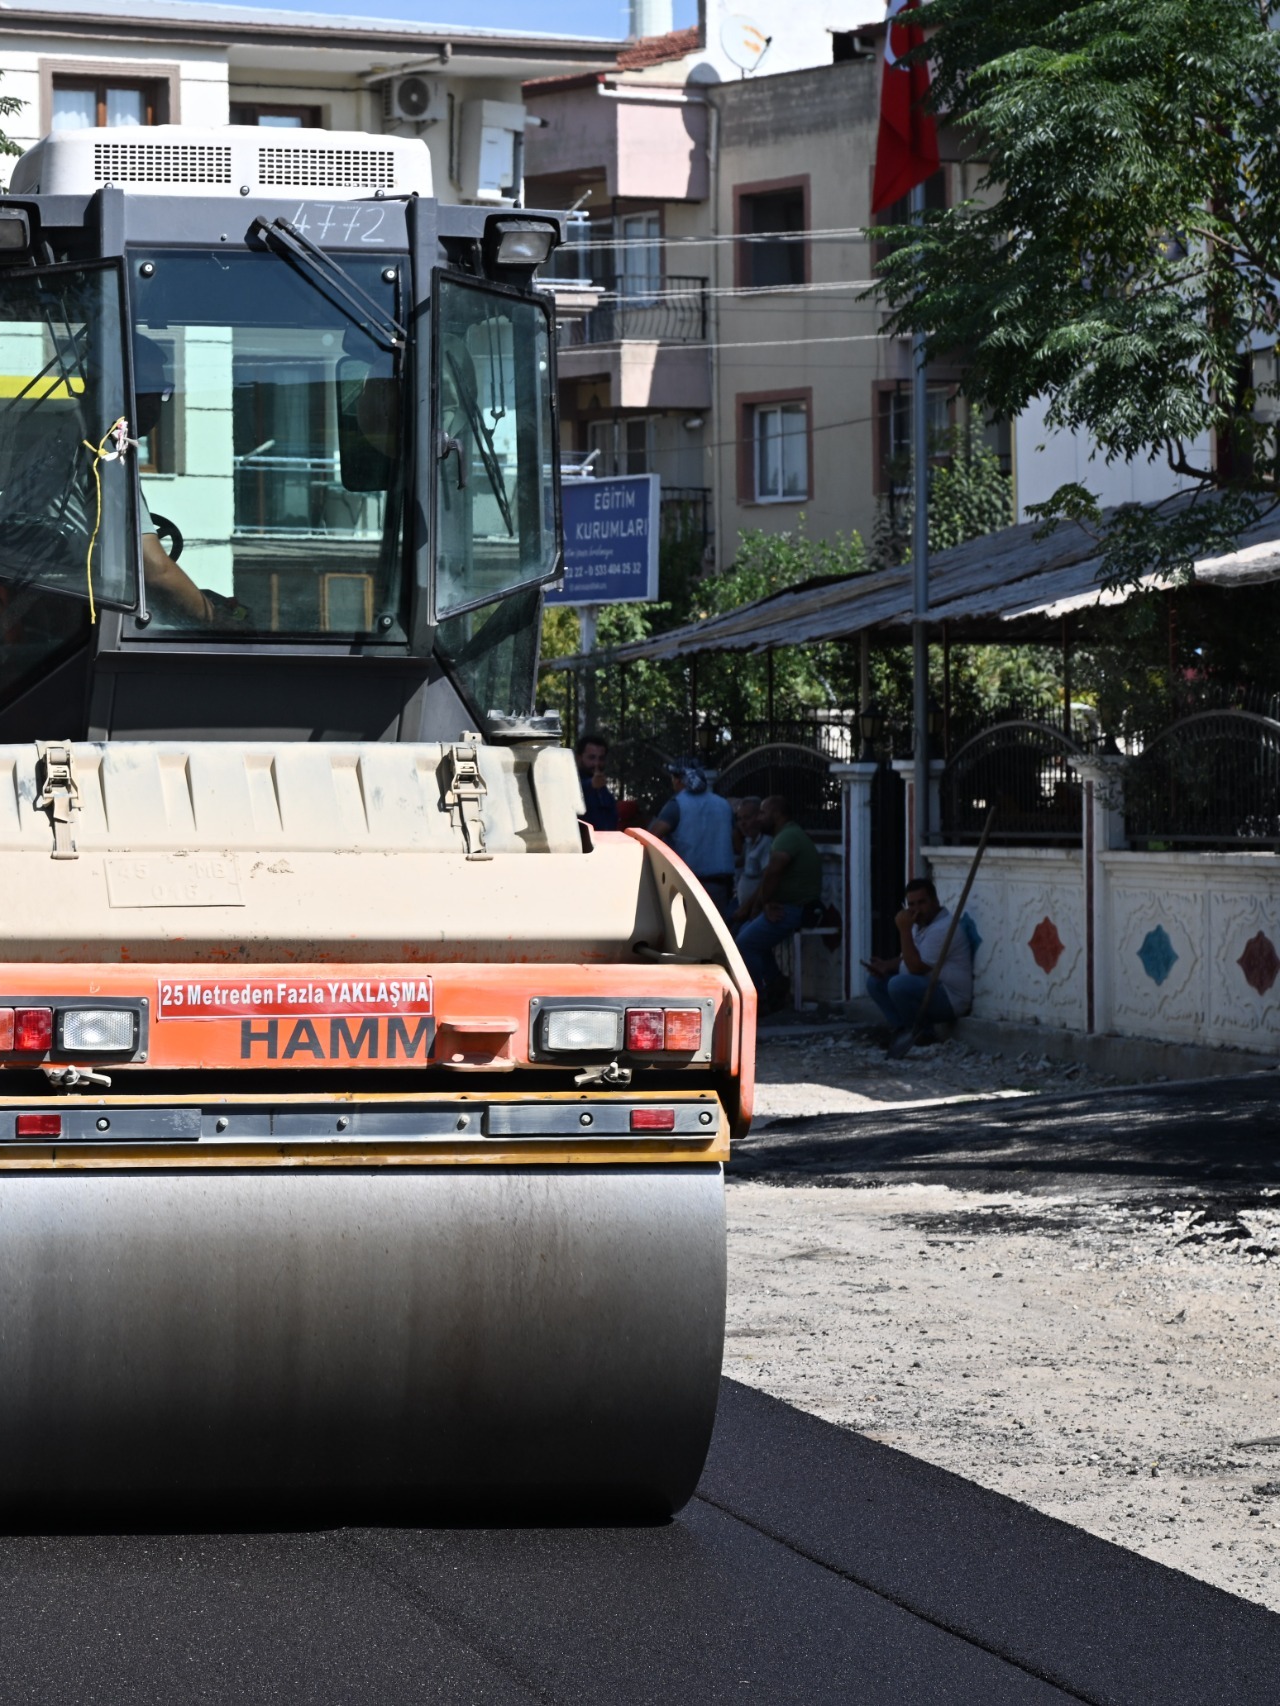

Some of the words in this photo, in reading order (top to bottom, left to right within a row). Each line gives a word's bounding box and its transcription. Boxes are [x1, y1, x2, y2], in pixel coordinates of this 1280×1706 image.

[291, 202, 385, 242] 4772
[594, 485, 636, 510] EĞİTİM
[575, 518, 648, 540] KURUMLARI
[162, 984, 184, 1006] 25
[187, 983, 272, 1006] Metreden
[277, 983, 324, 1004] Fazla
[327, 982, 429, 1008] YAKLAŞMA
[240, 1016, 436, 1059] HAMM
